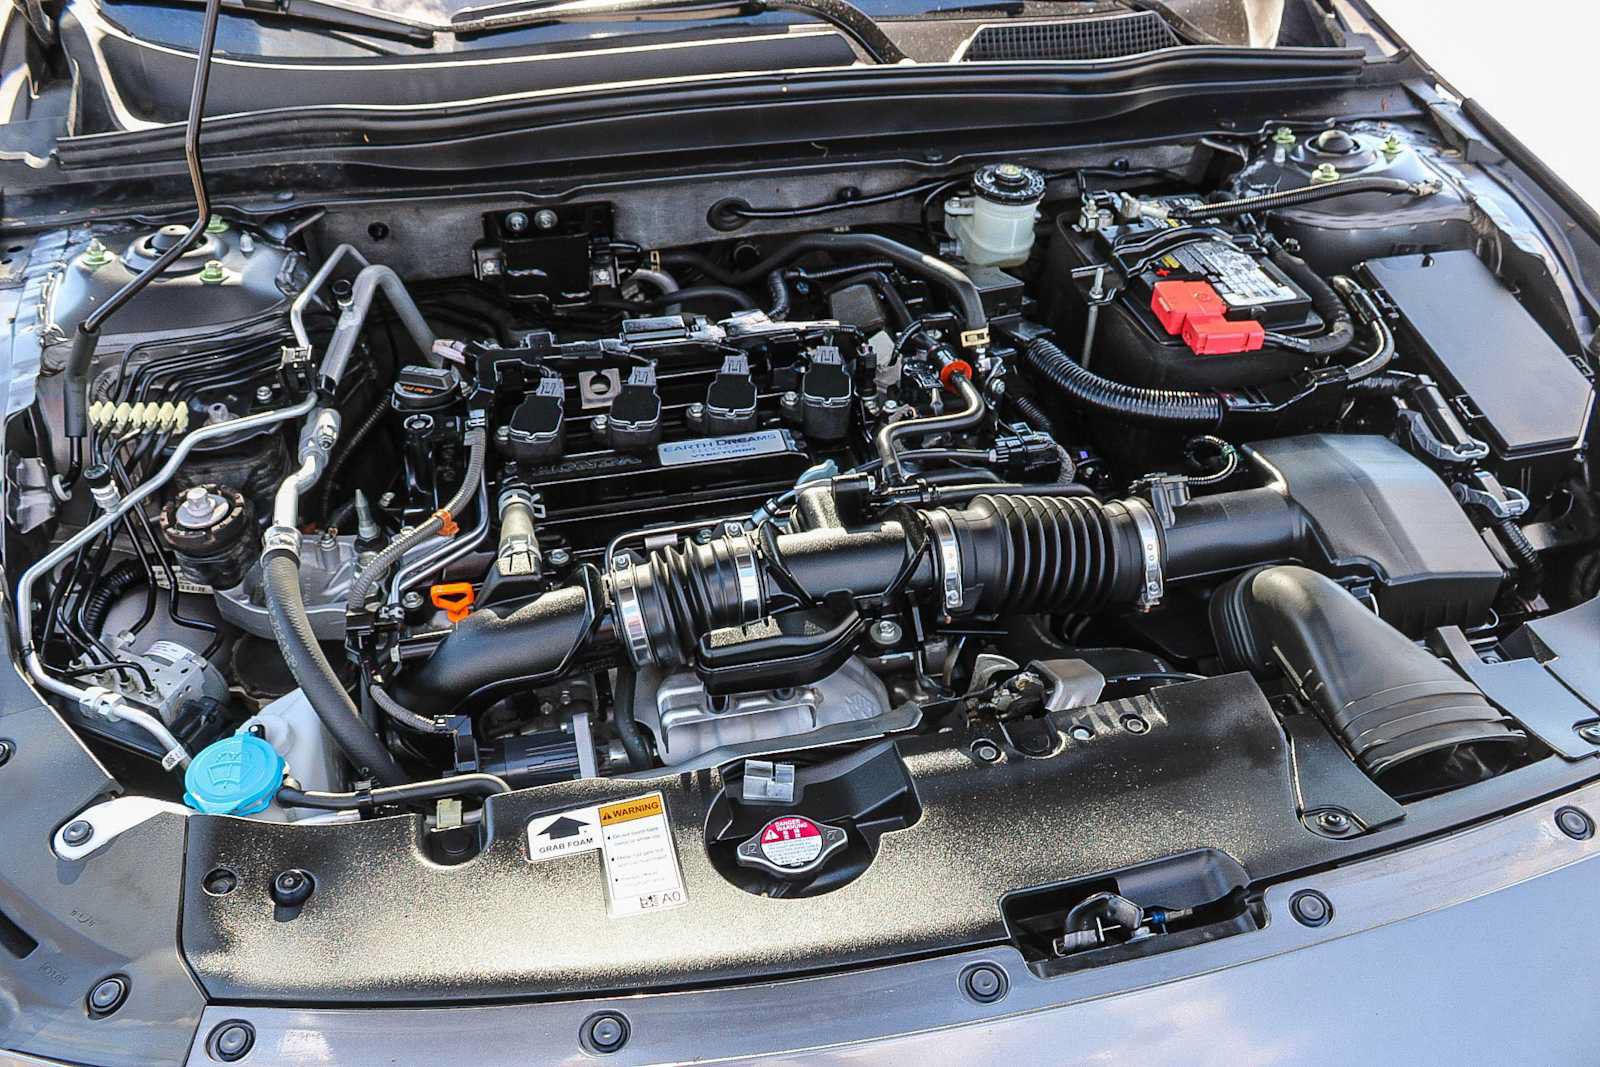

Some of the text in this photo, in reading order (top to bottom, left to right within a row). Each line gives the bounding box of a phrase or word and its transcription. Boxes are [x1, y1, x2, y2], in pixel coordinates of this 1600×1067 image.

[663, 433, 777, 453] EARTH DREAMS
[612, 801, 659, 818] WARNING
[538, 836, 594, 854] GRAB FOAM
